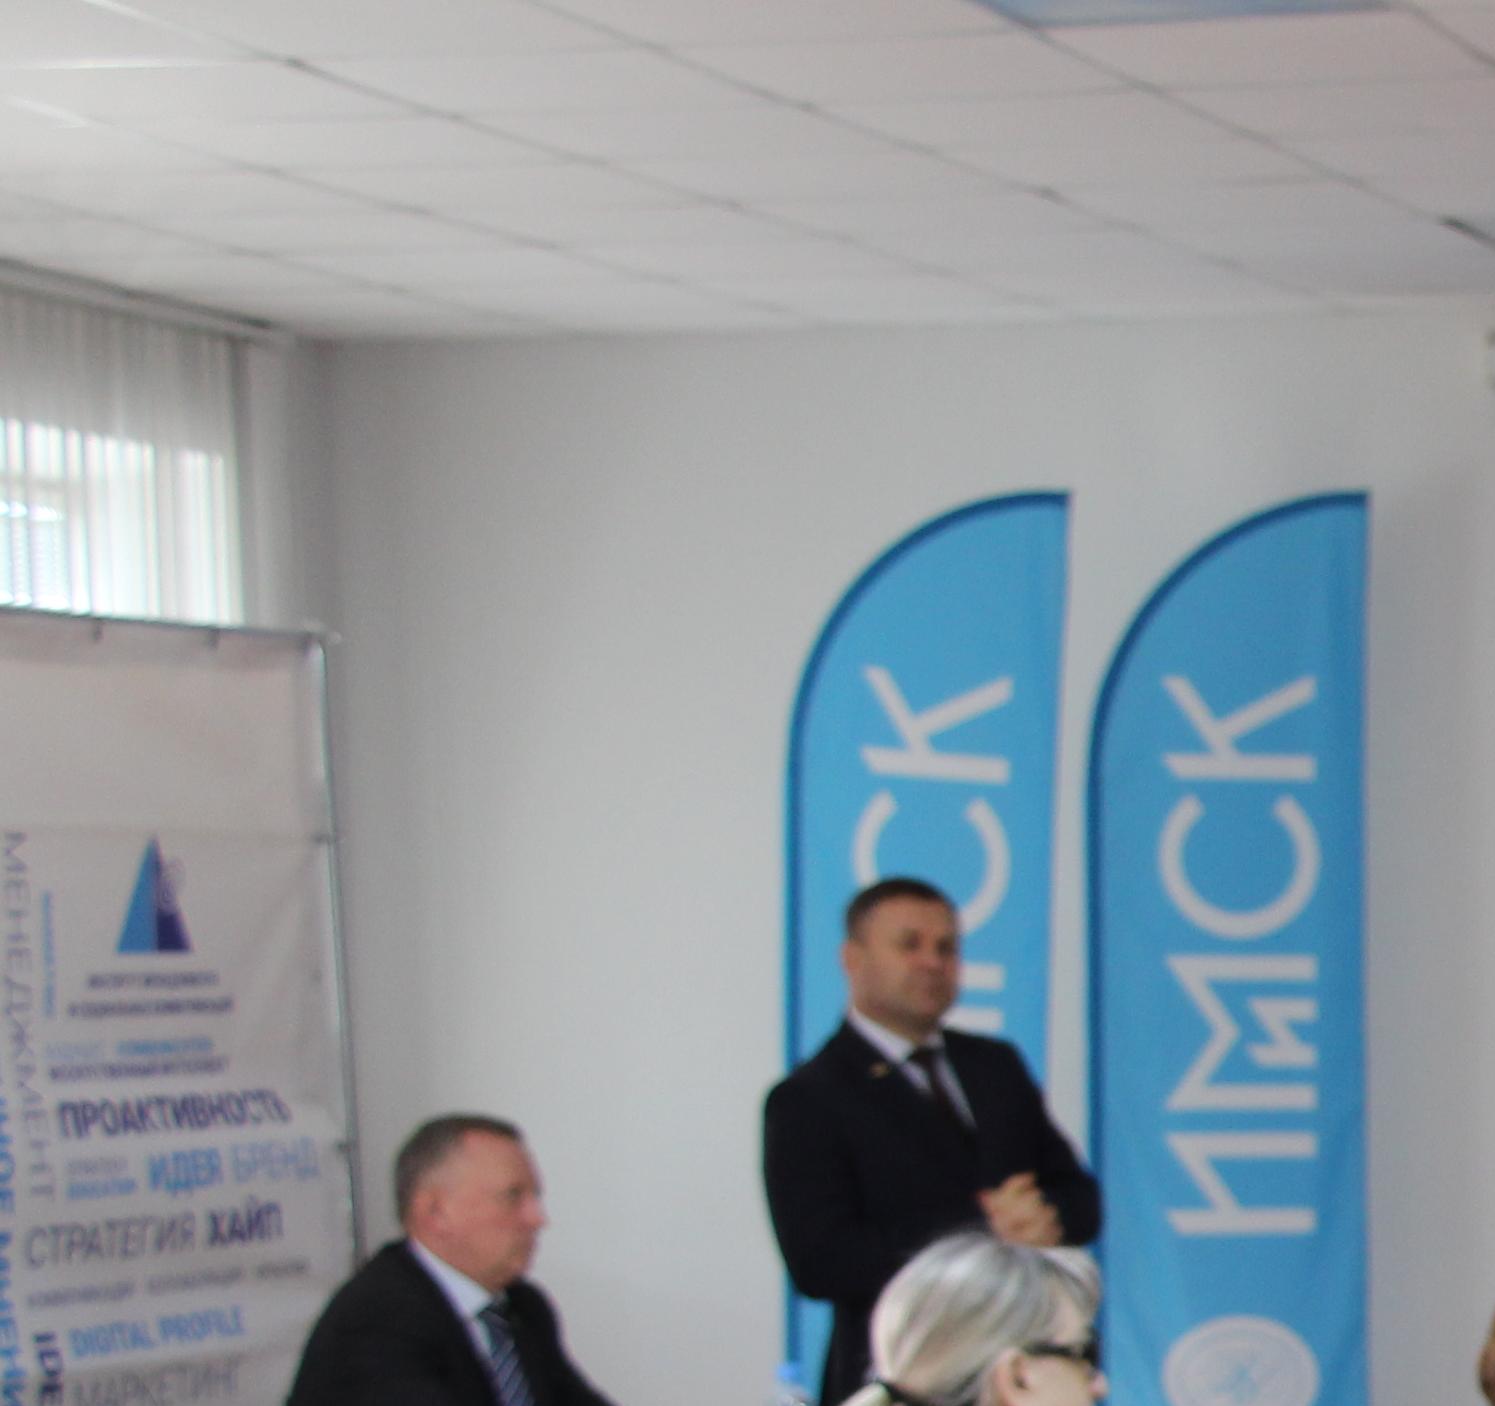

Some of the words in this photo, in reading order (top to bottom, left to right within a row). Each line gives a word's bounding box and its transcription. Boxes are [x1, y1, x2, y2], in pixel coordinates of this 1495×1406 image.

[57, 1087, 293, 1142] ПРОАКТИВНОСТЬ
[146, 1145, 223, 1198] ИДЕЯ
[230, 1135, 320, 1184] БРЕНД
[25, 1210, 196, 1269] СТРАТЕГИЯ
[207, 1194, 283, 1247] ХАЙП
[68, 1320, 155, 1359] DIGITAL
[155, 1302, 246, 1344] PROFILE
